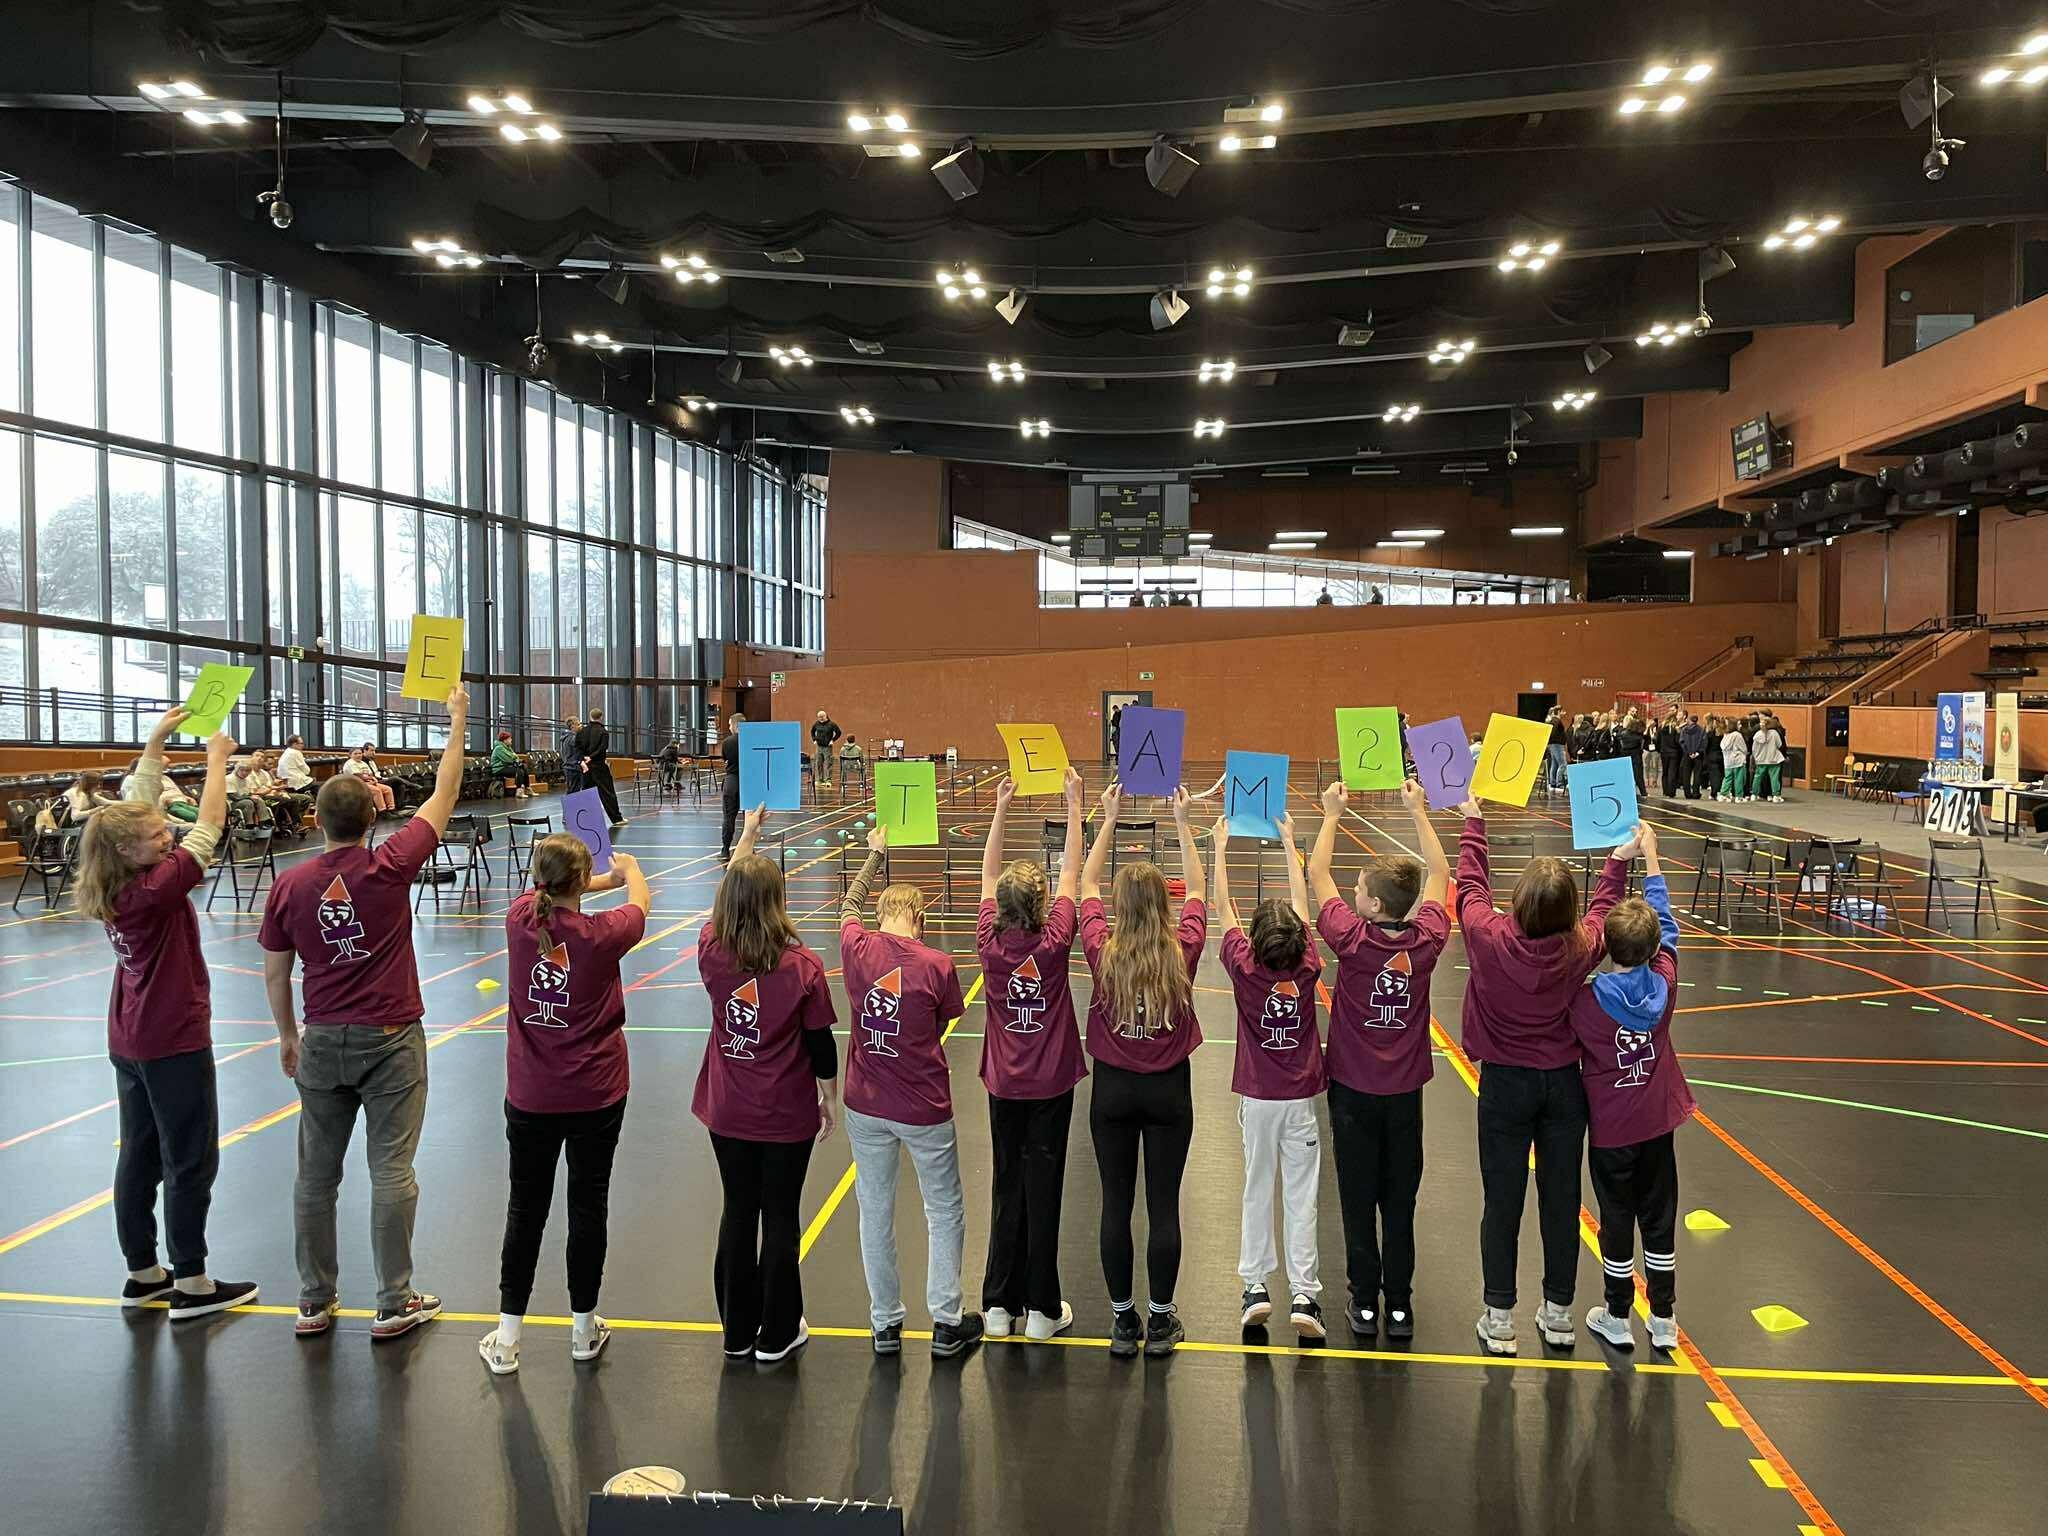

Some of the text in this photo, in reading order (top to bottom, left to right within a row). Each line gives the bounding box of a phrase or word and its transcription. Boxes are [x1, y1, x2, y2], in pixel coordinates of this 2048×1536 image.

[421, 636, 449, 679] E
[195, 681, 226, 717] B
[752, 747, 784, 791] T
[1019, 737, 1056, 772] E
[1130, 729, 1165, 776] A
[1356, 728, 1382, 770] 2
[1431, 741, 1466, 789] 2
[890, 784, 920, 825] T
[1231, 775, 1268, 819] M
[1590, 782, 1622, 827] 5
[575, 809, 602, 857] S
